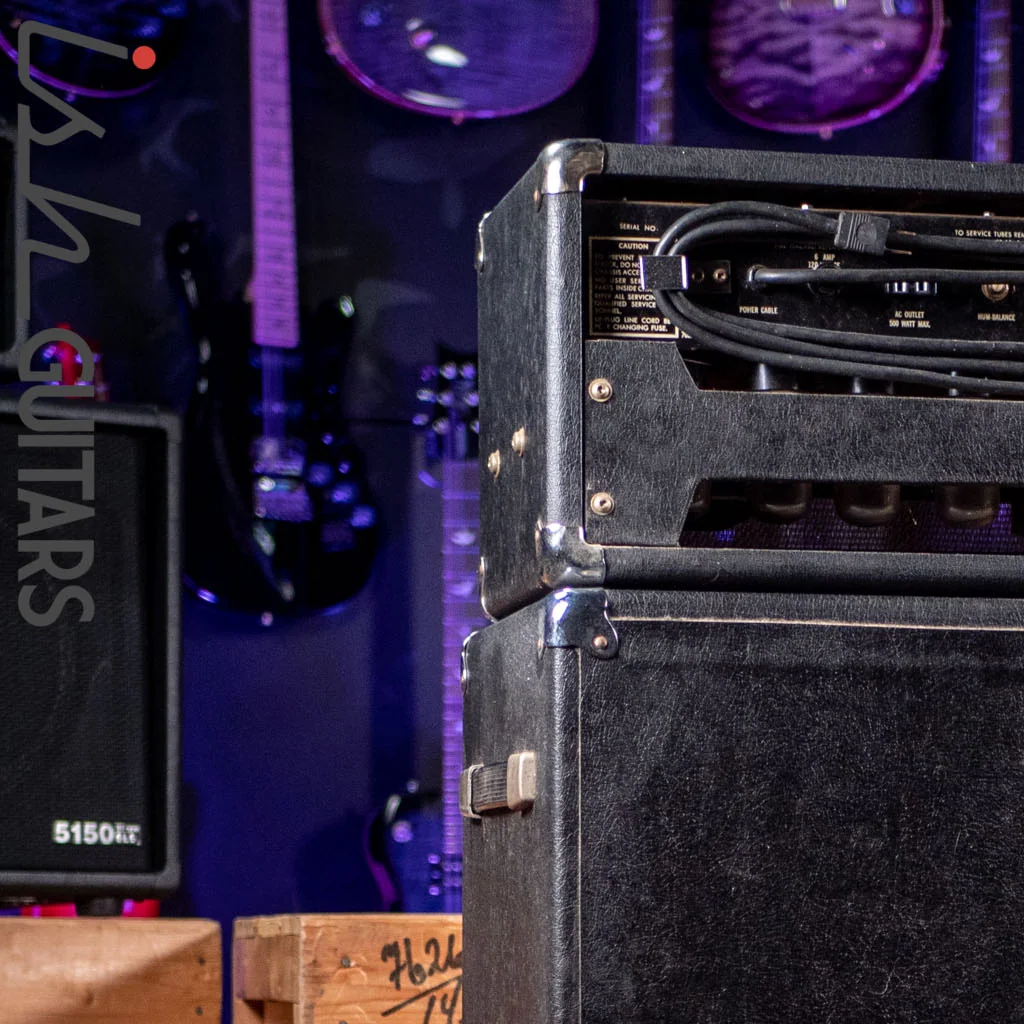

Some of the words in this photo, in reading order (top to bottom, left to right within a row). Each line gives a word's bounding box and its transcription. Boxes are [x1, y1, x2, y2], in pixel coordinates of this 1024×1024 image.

[619, 223, 640, 231] SERIAL
[955, 229, 964, 237] TO
[993, 230, 1012, 238] TUBES
[739, 306, 759, 314] POWER
[760, 306, 778, 314] CABLE
[904, 311, 925, 319] OUTLET
[889, 319, 900, 327] 500
[901, 320, 916, 328] WATT
[54, 820, 114, 845] 5150
